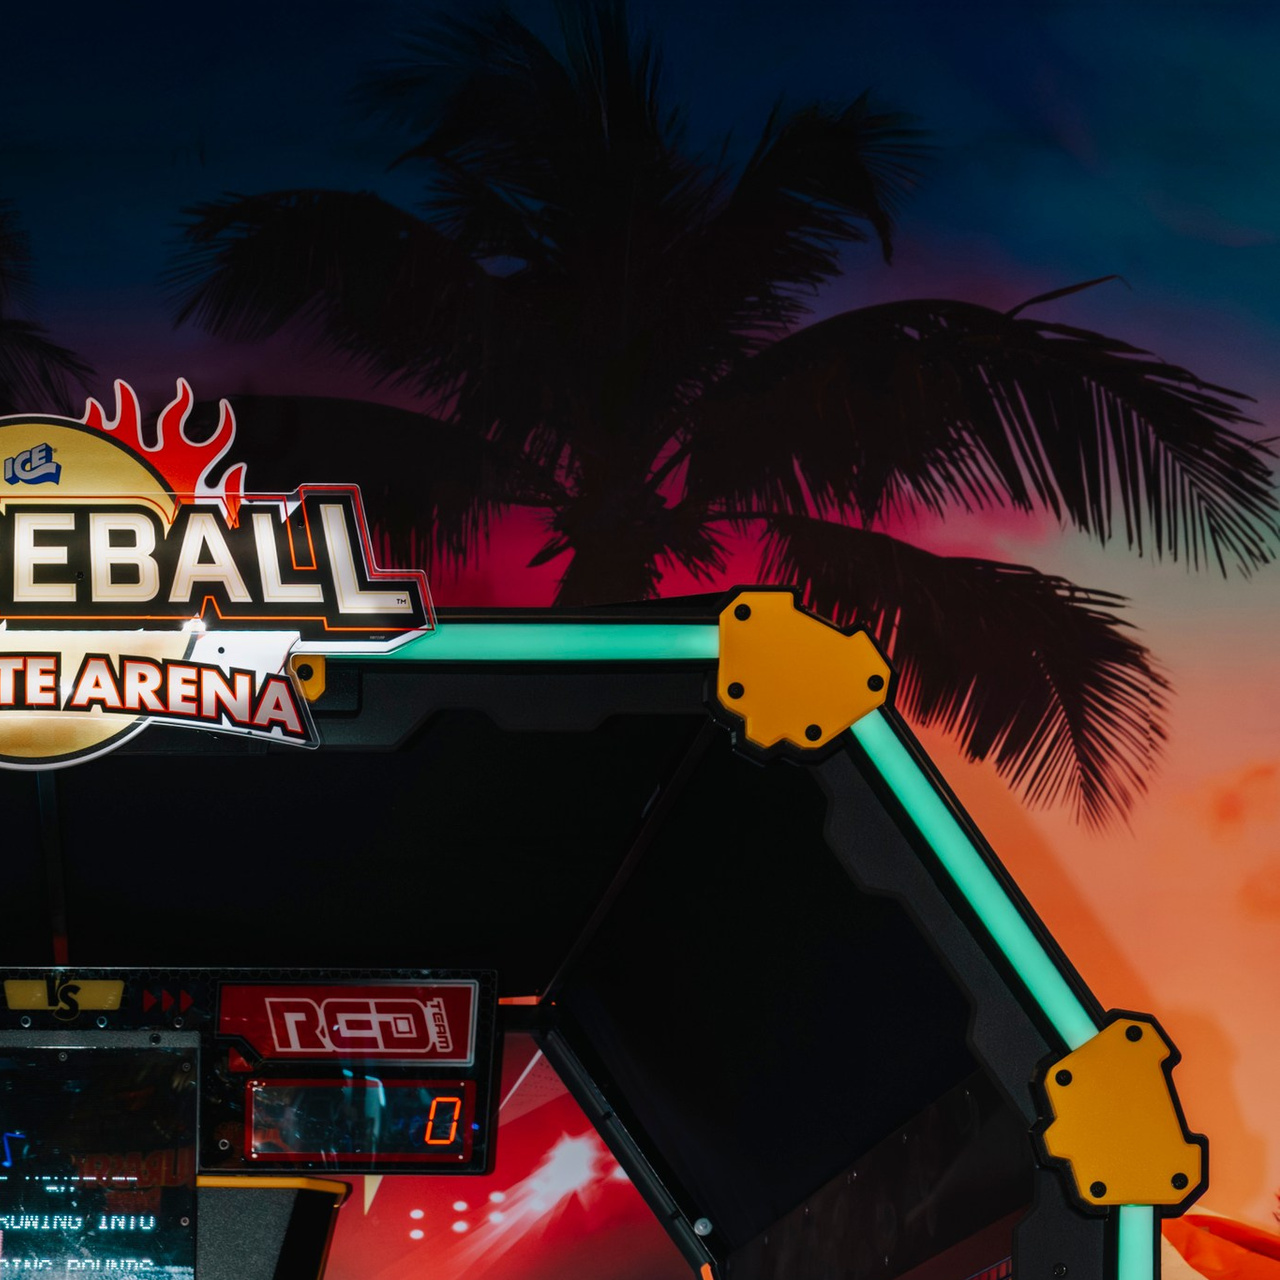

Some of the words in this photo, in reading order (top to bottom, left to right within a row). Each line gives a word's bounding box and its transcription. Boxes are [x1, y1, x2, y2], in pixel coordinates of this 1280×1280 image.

[3, 442, 62, 486] ICE
[64, 657, 305, 733] ARENA
[265, 997, 433, 1053] RED
[427, 998, 451, 1050] TEAM
[425, 1097, 462, 1145] 0
